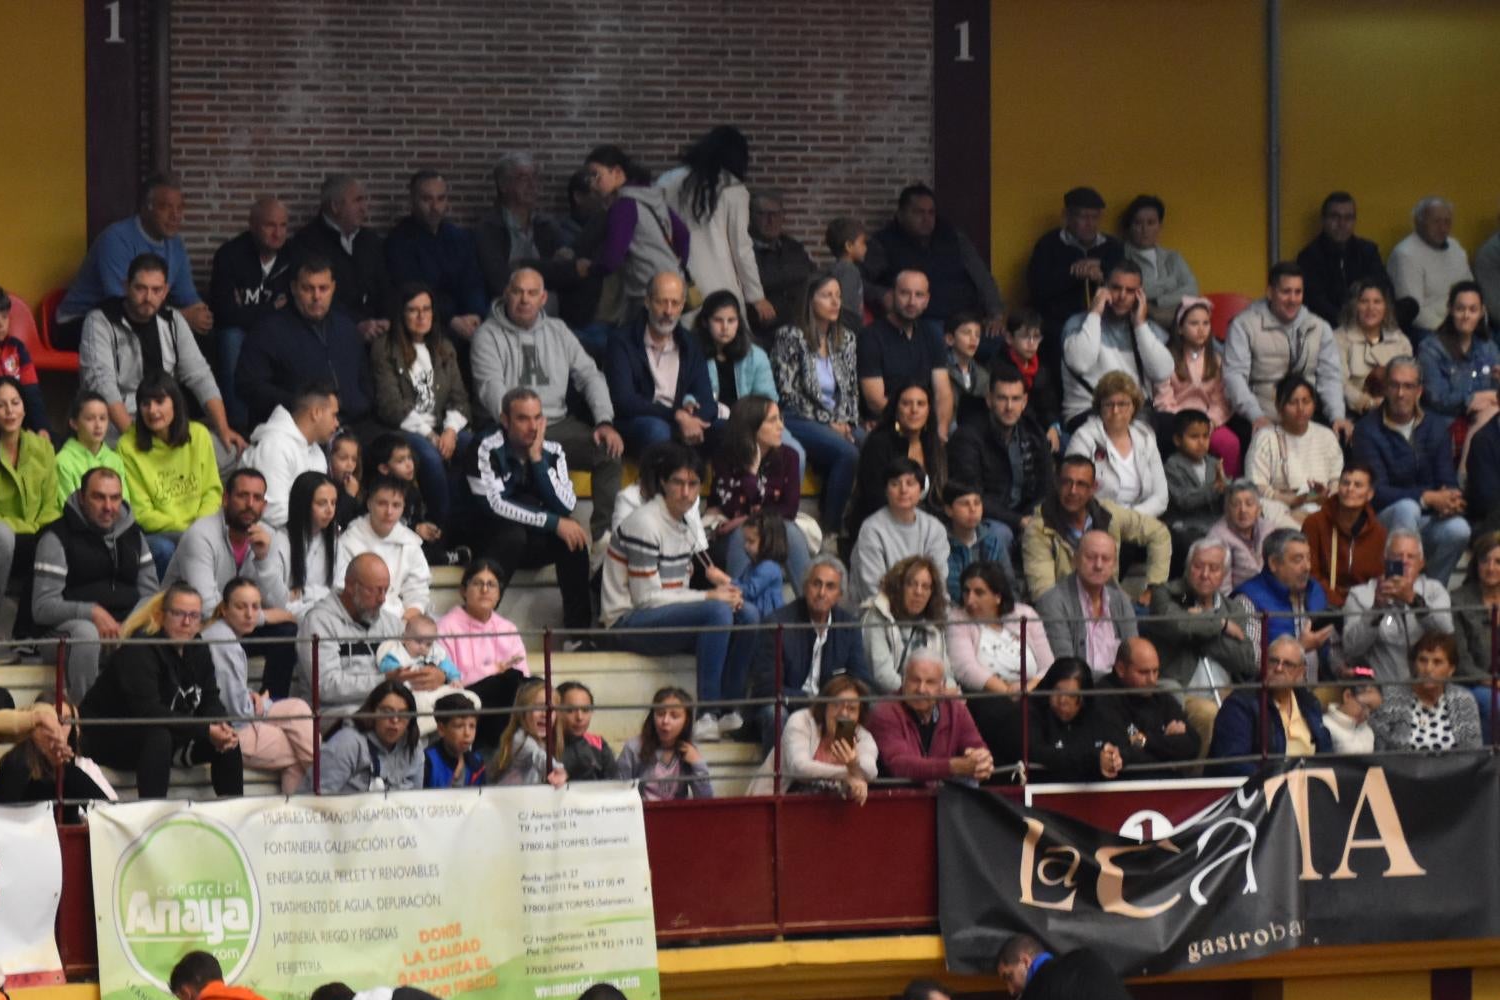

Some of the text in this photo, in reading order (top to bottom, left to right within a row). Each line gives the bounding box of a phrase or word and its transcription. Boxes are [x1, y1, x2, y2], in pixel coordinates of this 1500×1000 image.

[104, 0, 125, 43] 1
[954, 20, 975, 61] 1
[518, 344, 550, 389] A
[397, 836, 418, 849] GAS
[156, 880, 240, 895] comercial
[379, 864, 439, 880] RENOVABLES
[125, 890, 250, 945] Anaya
[1187, 920, 1303, 964] gastroba
